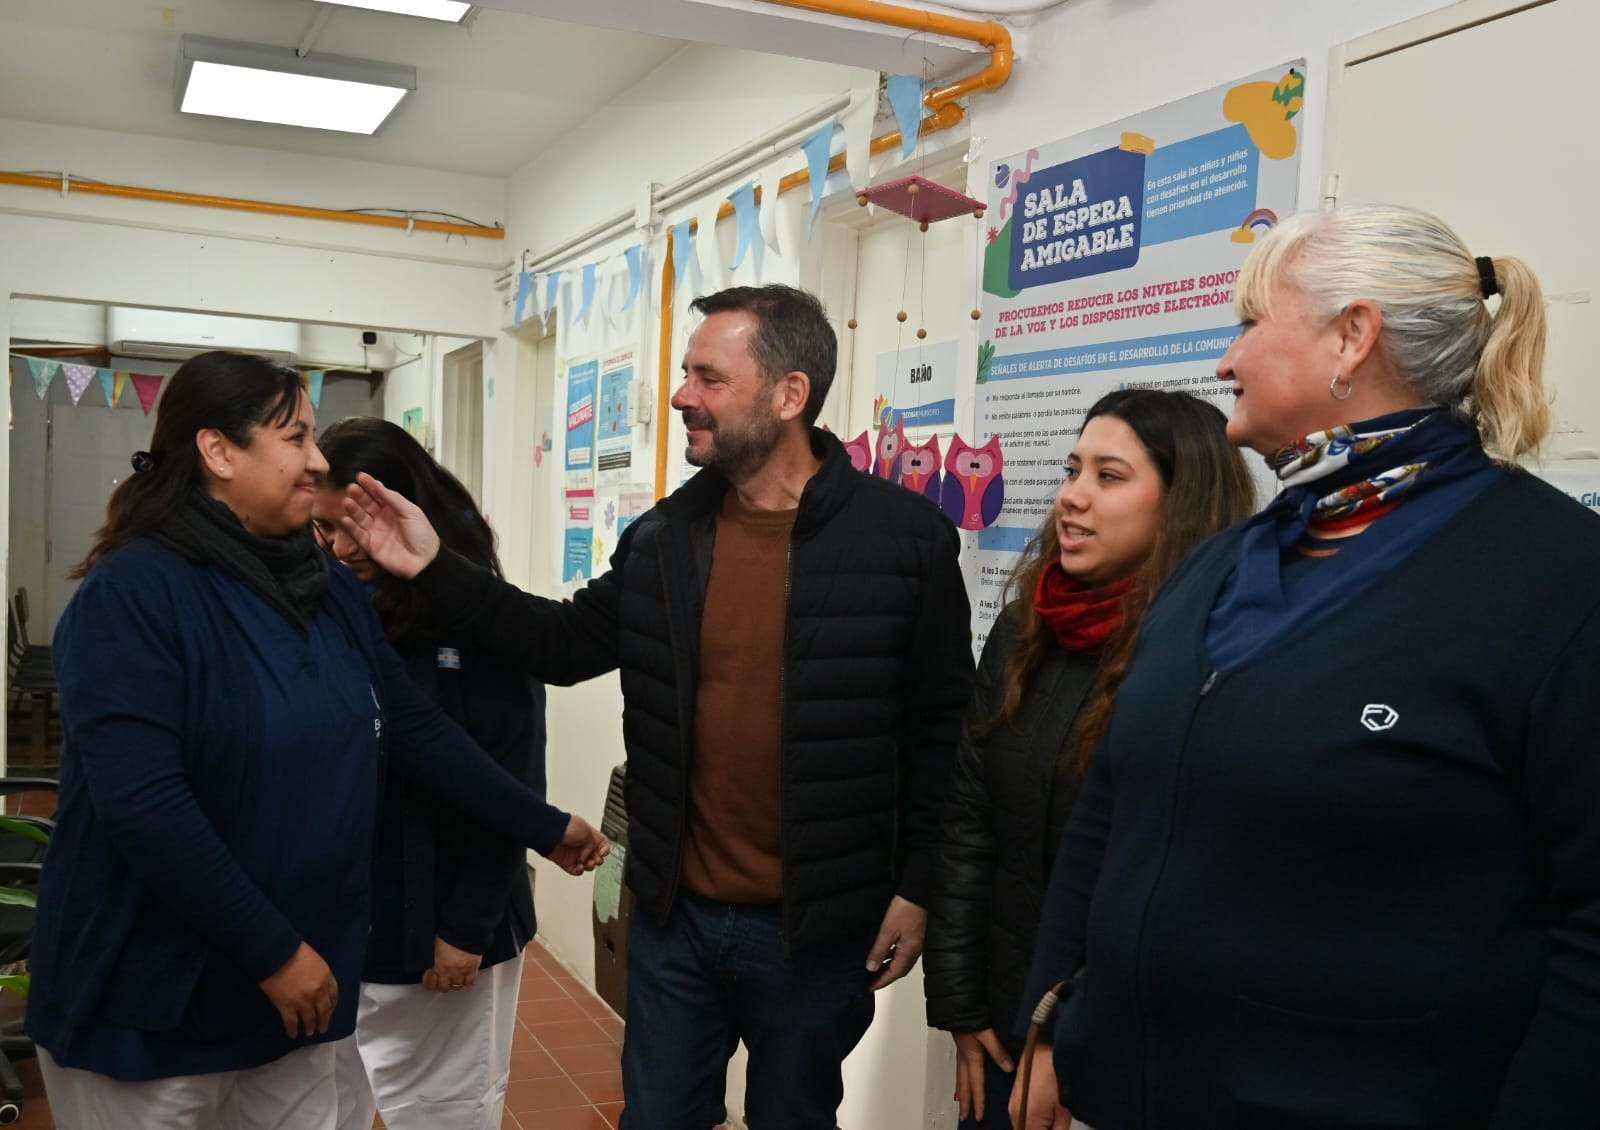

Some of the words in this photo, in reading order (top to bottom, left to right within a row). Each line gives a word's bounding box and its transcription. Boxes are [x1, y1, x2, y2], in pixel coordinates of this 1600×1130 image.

[1146, 194, 1159, 205] con
[1190, 180, 1200, 191] en
[1200, 175, 1208, 187] el
[1209, 163, 1248, 184] desarrollo
[1147, 180, 1156, 191] En
[1157, 175, 1172, 188] esta
[1172, 170, 1187, 182] sala
[1188, 166, 1199, 177] las
[1199, 158, 1220, 174] niñas
[1220, 157, 1226, 167] y
[1227, 149, 1248, 164] niños
[1024, 178, 1088, 218] SALA
[1146, 204, 1168, 219] tienen
[1169, 192, 1202, 213] prioridad
[1203, 189, 1213, 201] de
[1214, 179, 1249, 197] atención.
[1022, 218, 1048, 244] DE
[1052, 195, 1134, 237] ESPERA
[1020, 222, 1135, 272] AMIGABLE
[995, 326, 1008, 339] DE
[1010, 324, 1024, 337] LA
[1027, 320, 1047, 334] VOZ
[1049, 319, 1057, 331] Y
[1059, 315, 1079, 330] LOS
[1081, 302, 1161, 326] DISPOSITIVOS
[998, 301, 1065, 323] PROCUREMOS
[1067, 293, 1114, 312] REDUCIR
[1117, 288, 1139, 303] LOS
[1142, 278, 1195, 299] NIVELES
[910, 363, 932, 384] BAÑO
[990, 362, 1018, 376] SEÑALES
[1019, 361, 1028, 373] DE
[1028, 359, 1053, 371] ALERTA
[1053, 357, 1063, 369] DE
[1063, 353, 1097, 367] DESAFÍOS
[1097, 352, 1108, 364] EN
[1109, 351, 1117, 362] EL
[1119, 344, 1169, 361] DESARROLLO
[1170, 342, 1181, 355] DE
[1182, 342, 1193, 353] LA
